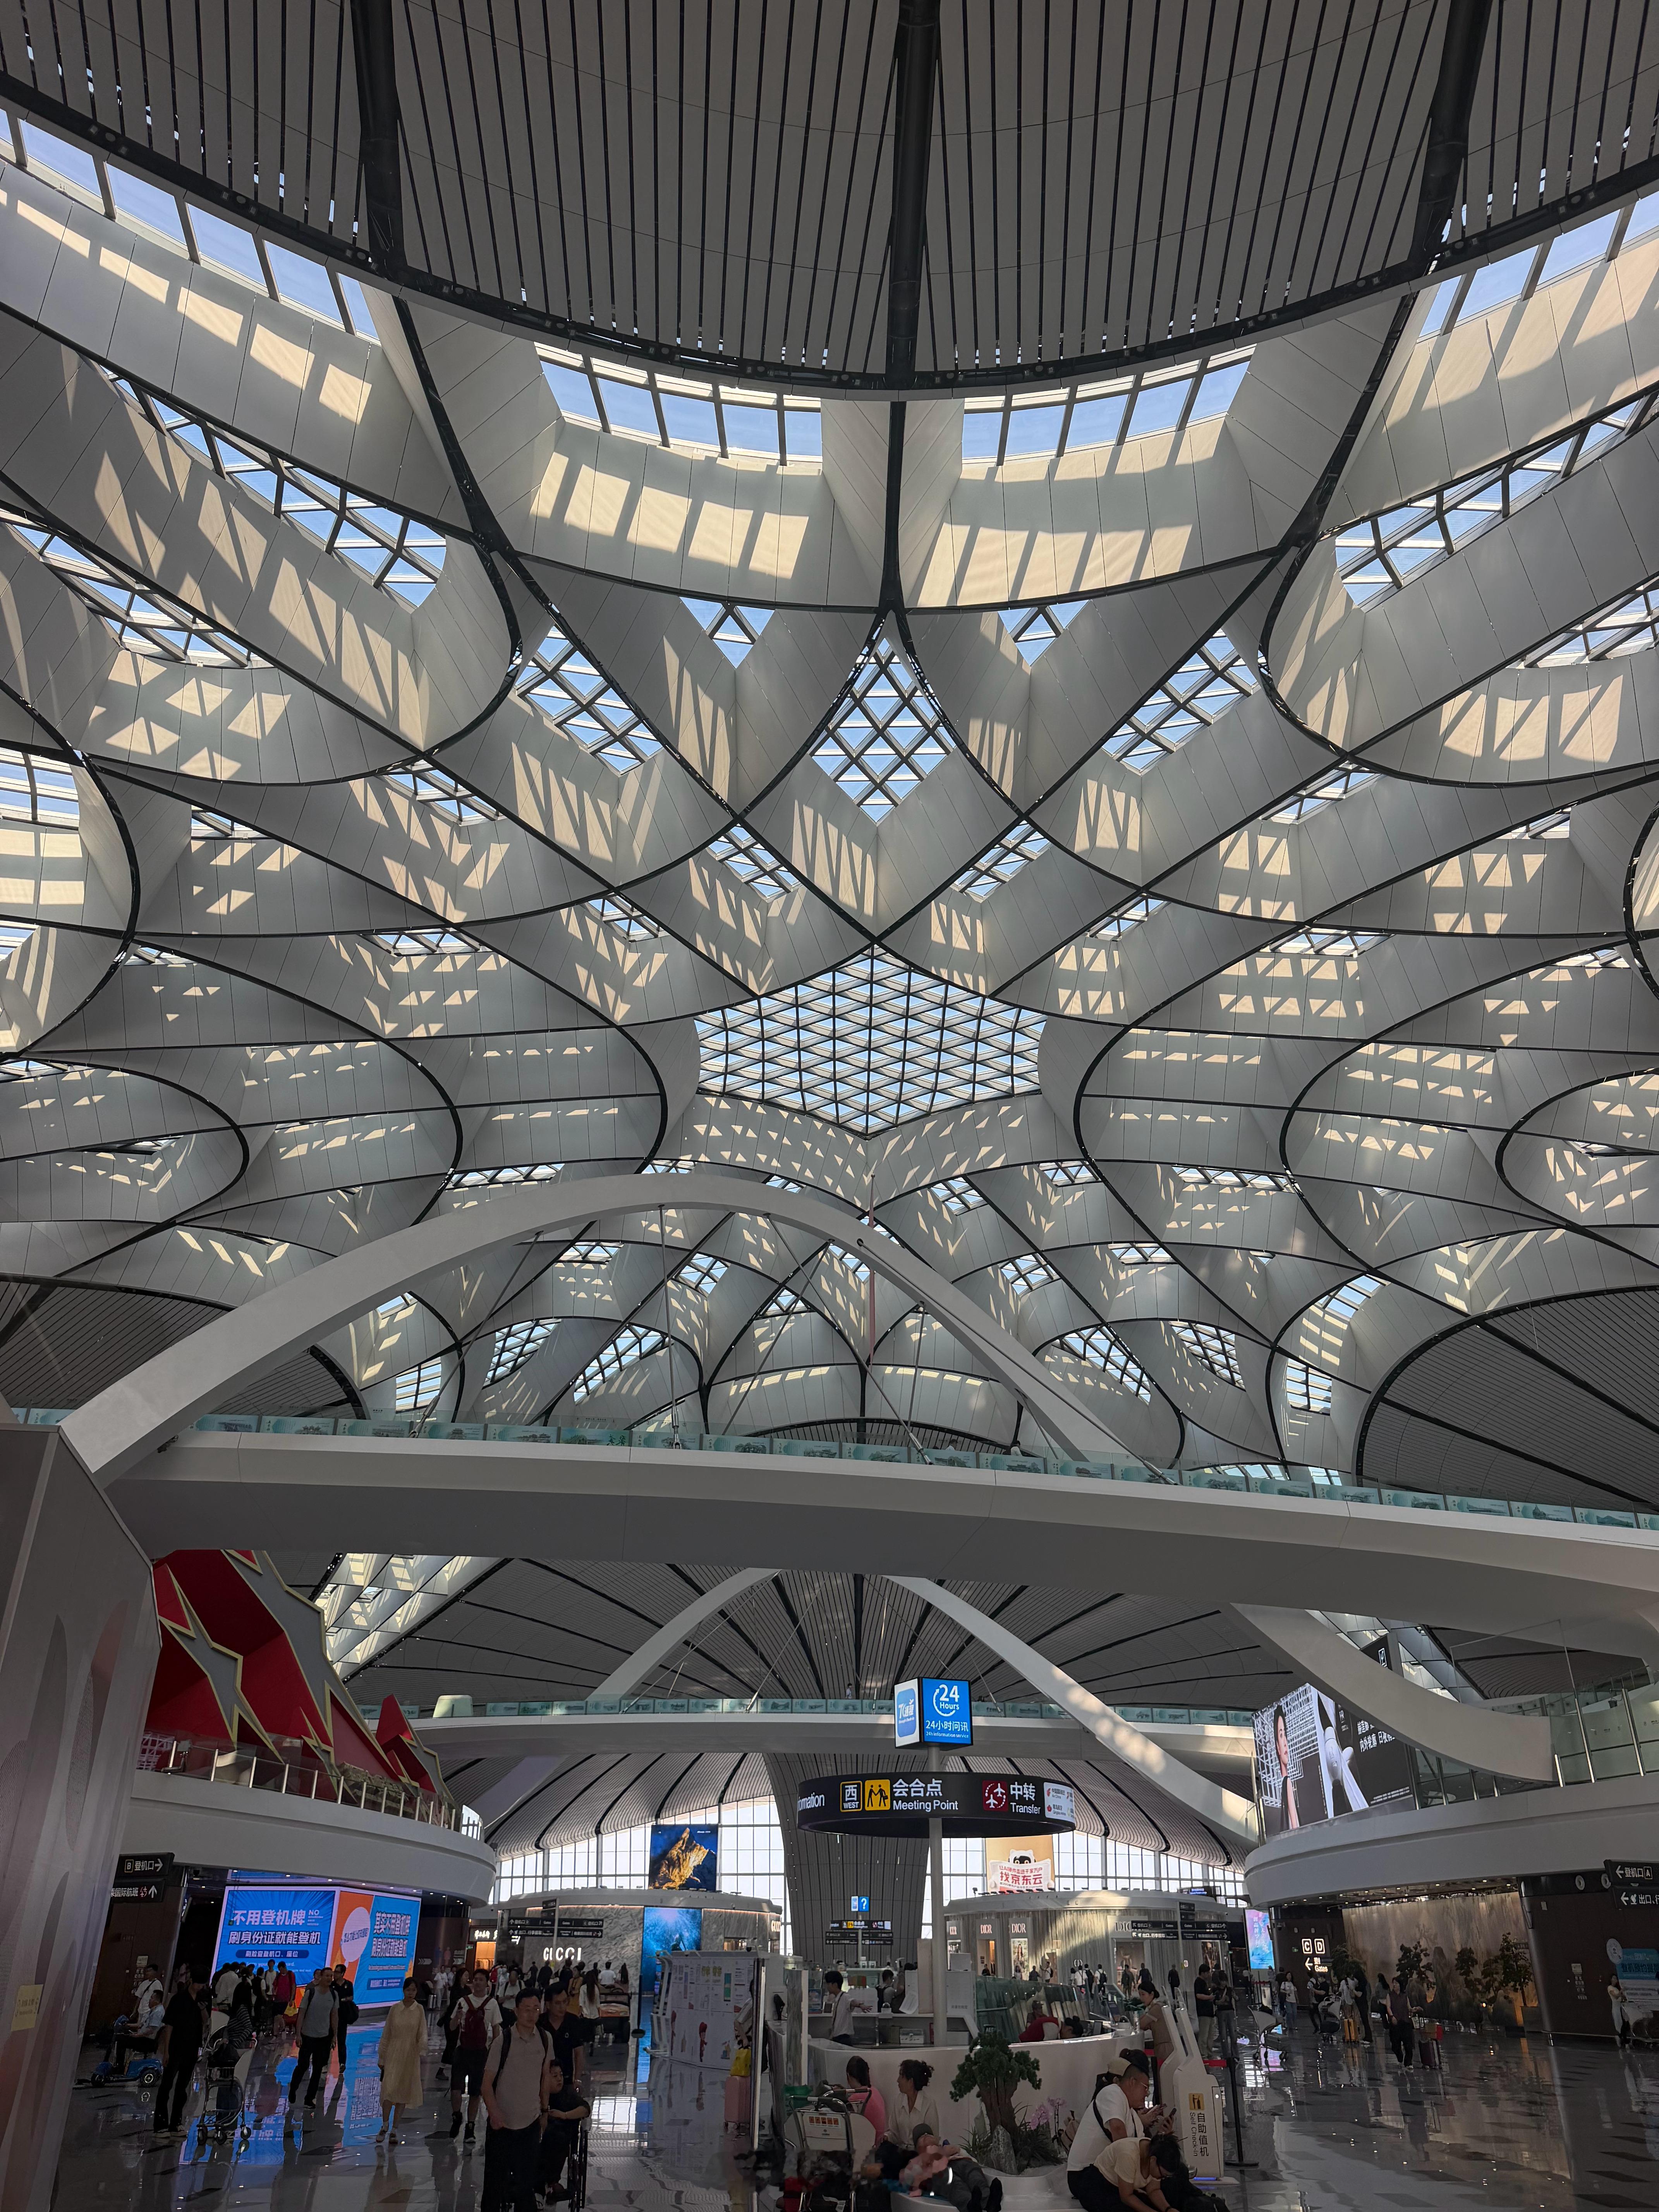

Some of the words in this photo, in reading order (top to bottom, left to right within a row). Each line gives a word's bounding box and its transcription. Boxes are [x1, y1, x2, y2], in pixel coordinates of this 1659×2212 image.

[939, 1684, 960, 1702] 24
[926, 1720, 969, 1732] 24小时问讯
[845, 1784, 857, 1801] 西
[893, 1778, 942, 1796] 会合点
[1010, 1781, 1036, 1801] 中转
[893, 1800, 931, 1812] Meeting
[934, 1800, 958, 1810] Point
[1010, 1803, 1041, 1814] Transfer
[134, 1860, 154, 1871] 登机口
[1000, 1871, 1042, 1885] 找京东云
[1625, 1867, 1644, 1877] 登机口
[233, 1910, 306, 1925] 不用登机牌
[981, 1924, 992, 1934] DIOR
[1012, 1923, 1026, 1933] DIOR
[228, 1931, 320, 1944] 刷身份证就能登机
[1304, 1942, 1310, 1951] C
[1317, 1942, 1322, 1951] D
[1197, 2112, 1209, 2157] 自助值机
